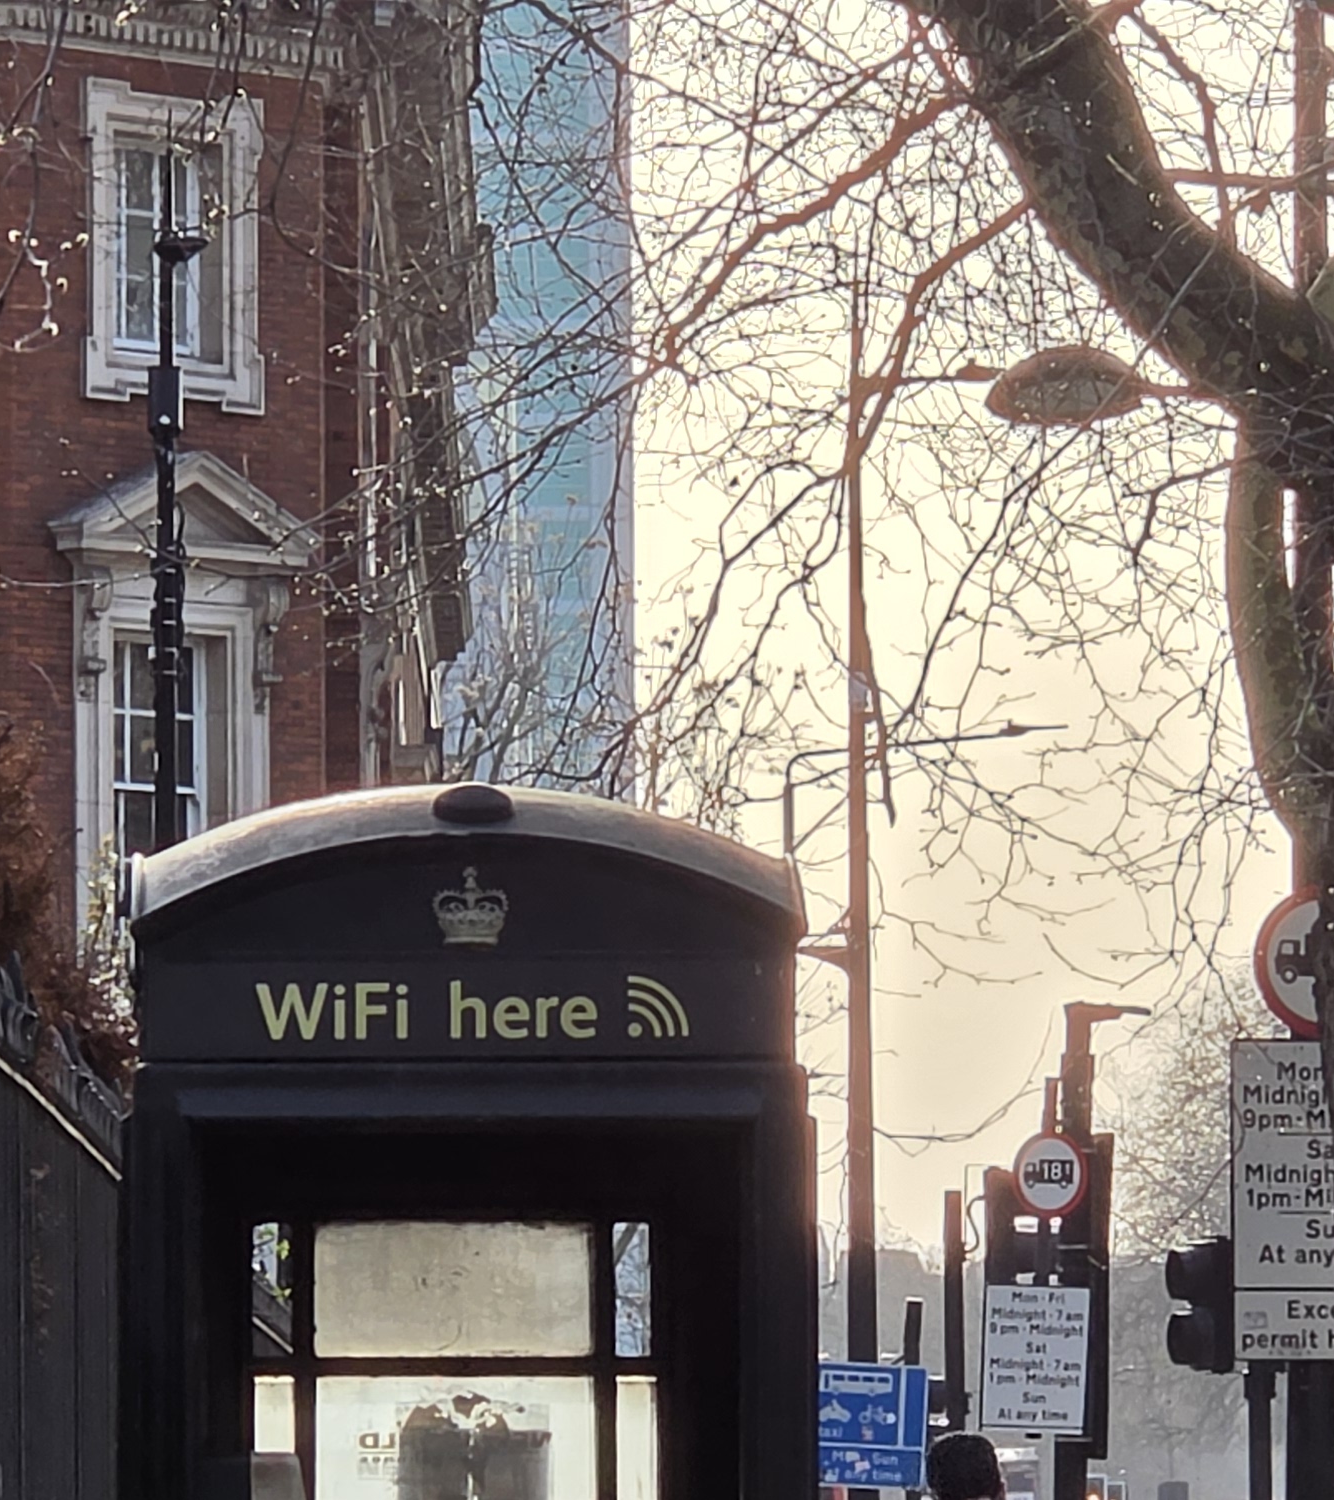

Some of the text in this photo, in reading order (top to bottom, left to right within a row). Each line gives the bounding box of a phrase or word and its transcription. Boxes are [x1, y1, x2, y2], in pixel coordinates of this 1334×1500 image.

[256, 980, 598, 1040] WiFi here
[1244, 1085, 1326, 1108] Midnig
[1259, 1245, 1285, 1264] At
[1012, 1292, 1038, 1303] Mon
[1048, 1292, 1066, 1304] Fri
[992, 1308, 1046, 1322] Midnight
[1055, 1310, 1063, 1321] 7
[1067, 1312, 1084, 1321] am
[1000, 1325, 1019, 1335] pm
[1029, 1324, 1083, 1338] Midnight
[1242, 1328, 1318, 1352] permit
[1026, 1342, 1047, 1354] Sat
[990, 1358, 1044, 1372] Midnight
[1054, 1359, 1062, 1371] 7
[1063, 1362, 1081, 1371] am
[996, 1375, 1015, 1385] pm
[1025, 1374, 1080, 1388] Midnight
[1022, 1392, 1047, 1404] Sun
[998, 1408, 1068, 1422] At any time
